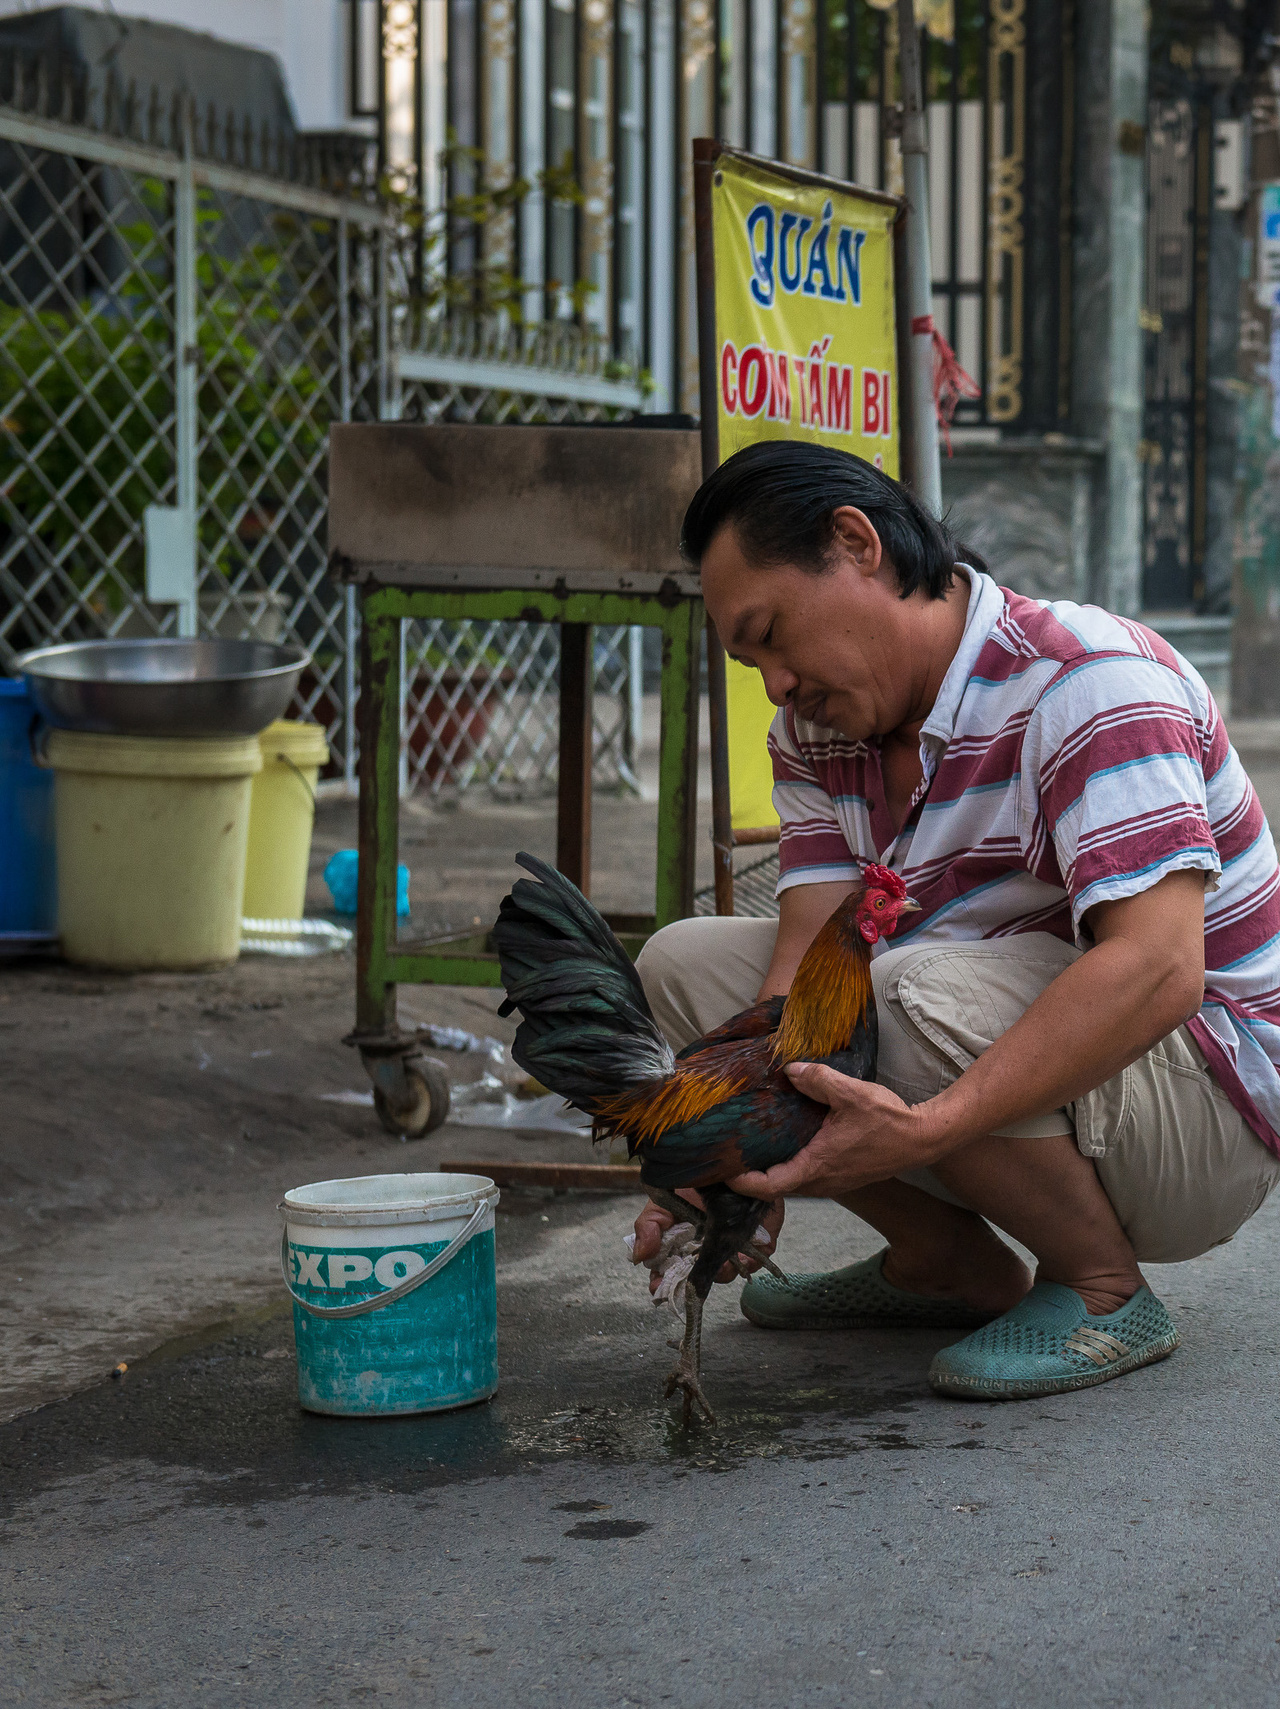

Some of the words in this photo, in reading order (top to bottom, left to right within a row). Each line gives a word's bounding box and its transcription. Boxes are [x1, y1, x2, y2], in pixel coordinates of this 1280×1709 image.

[748, 199, 866, 308] QUÁN
[792, 335, 853, 434] TẤM
[862, 367, 891, 439] BI
[944, 1375, 1001, 1390] FASHION
[1004, 1378, 1059, 1392] FASHION
[1063, 1372, 1107, 1388] FASHION
[1107, 1355, 1139, 1378] FASHION
